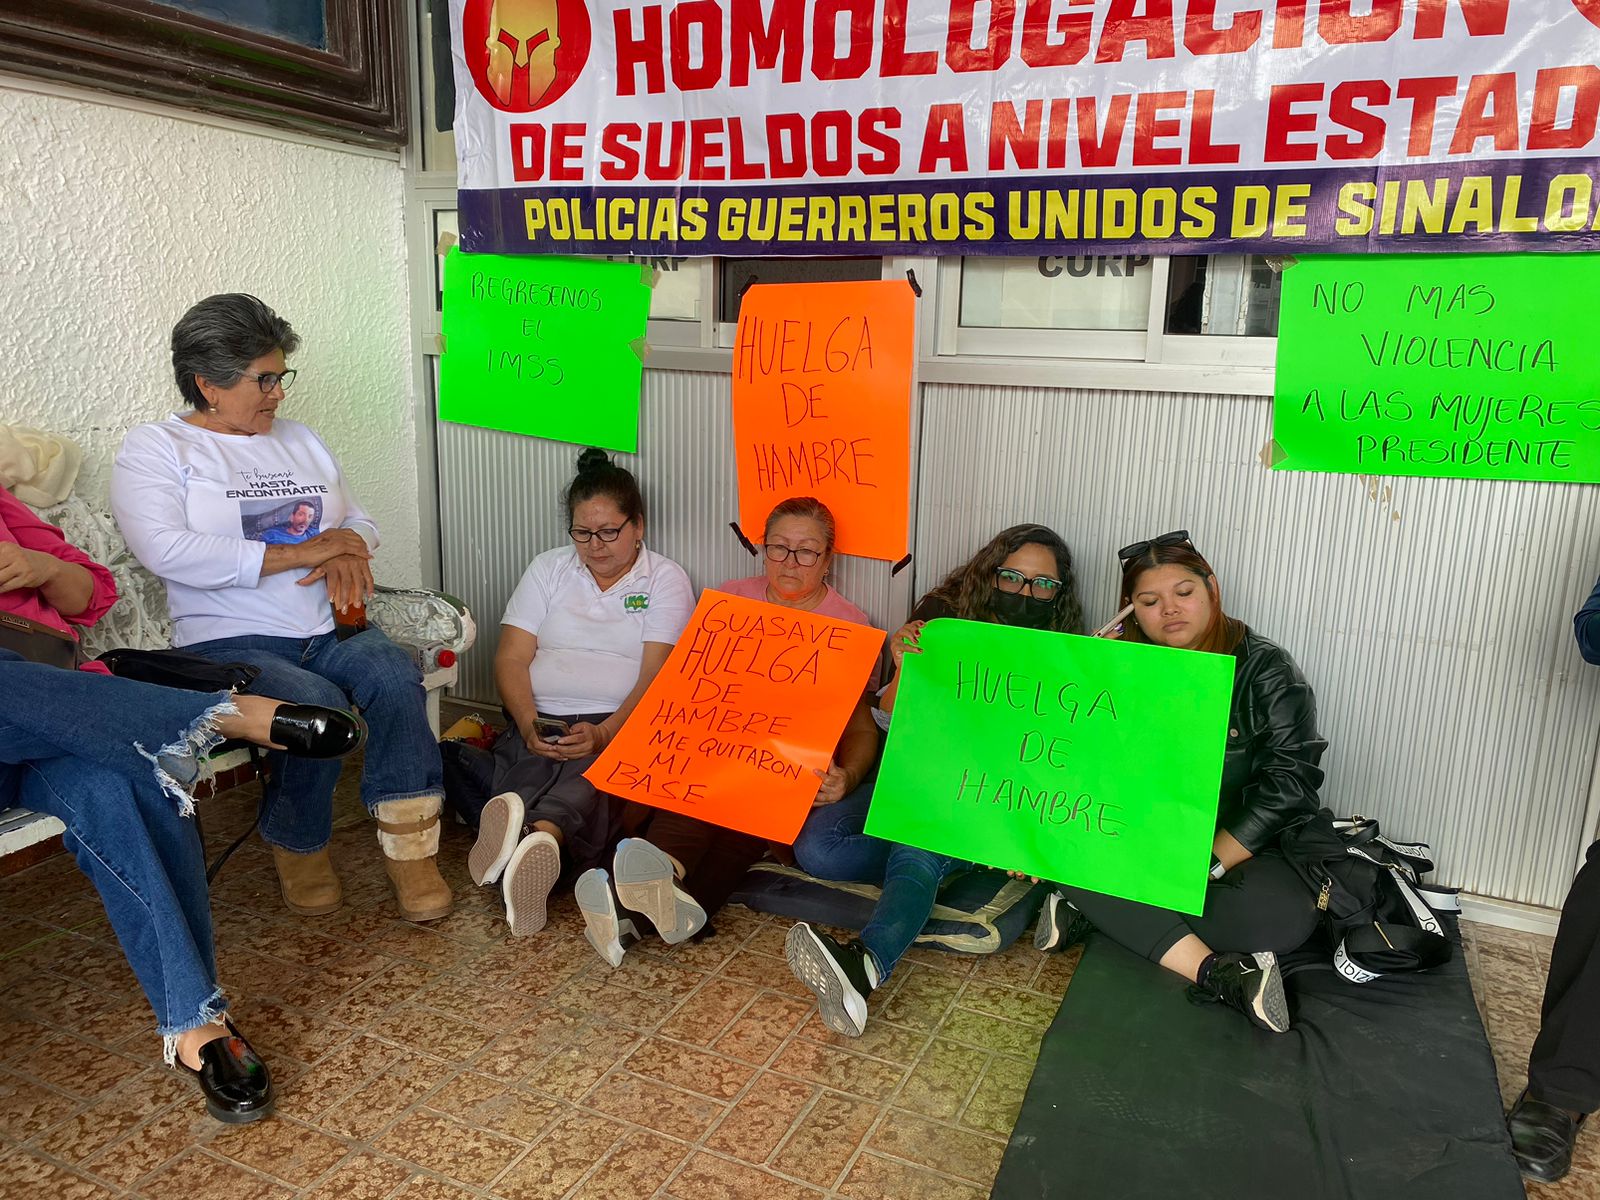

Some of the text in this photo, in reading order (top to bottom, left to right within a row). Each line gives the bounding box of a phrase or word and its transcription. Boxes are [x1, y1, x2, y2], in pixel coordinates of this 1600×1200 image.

[509, 65, 1600, 182] DE SUELDOS A NIVEL ESTAD
[525, 173, 1600, 242] POLICIAS GUERREROS UNIDOS DE SINALO
[1037, 255, 1150, 277] CURP
[471, 271, 602, 312] REGRESENOS
[1313, 281, 1495, 319] NO MAS
[522, 318, 544, 341] EL
[739, 315, 873, 384] HUELGA
[487, 349, 564, 386] IMSS
[1360, 331, 1559, 373] VIOLENCIA
[781, 382, 828, 428] DE
[1302, 389, 1600, 441] A LAS MUJERES
[753, 438, 877, 492] HAMBRE
[1357, 435, 1576, 469] PRESIDENTE
[226, 485, 328, 498] ENCONTRARTE
[249, 480, 297, 489] HASTA
[701, 600, 852, 651] GUASAVE
[680, 627, 821, 685] HUELGA
[690, 677, 743, 704] DE
[956, 661, 1118, 724] HUELGA
[650, 699, 792, 736] HAMBRE
[648, 729, 802, 780] ME QUITARON
[648, 752, 690, 775] MI
[1019, 730, 1073, 769] DE
[606, 760, 708, 804] BASE
[957, 768, 1128, 837] HAMBRE
